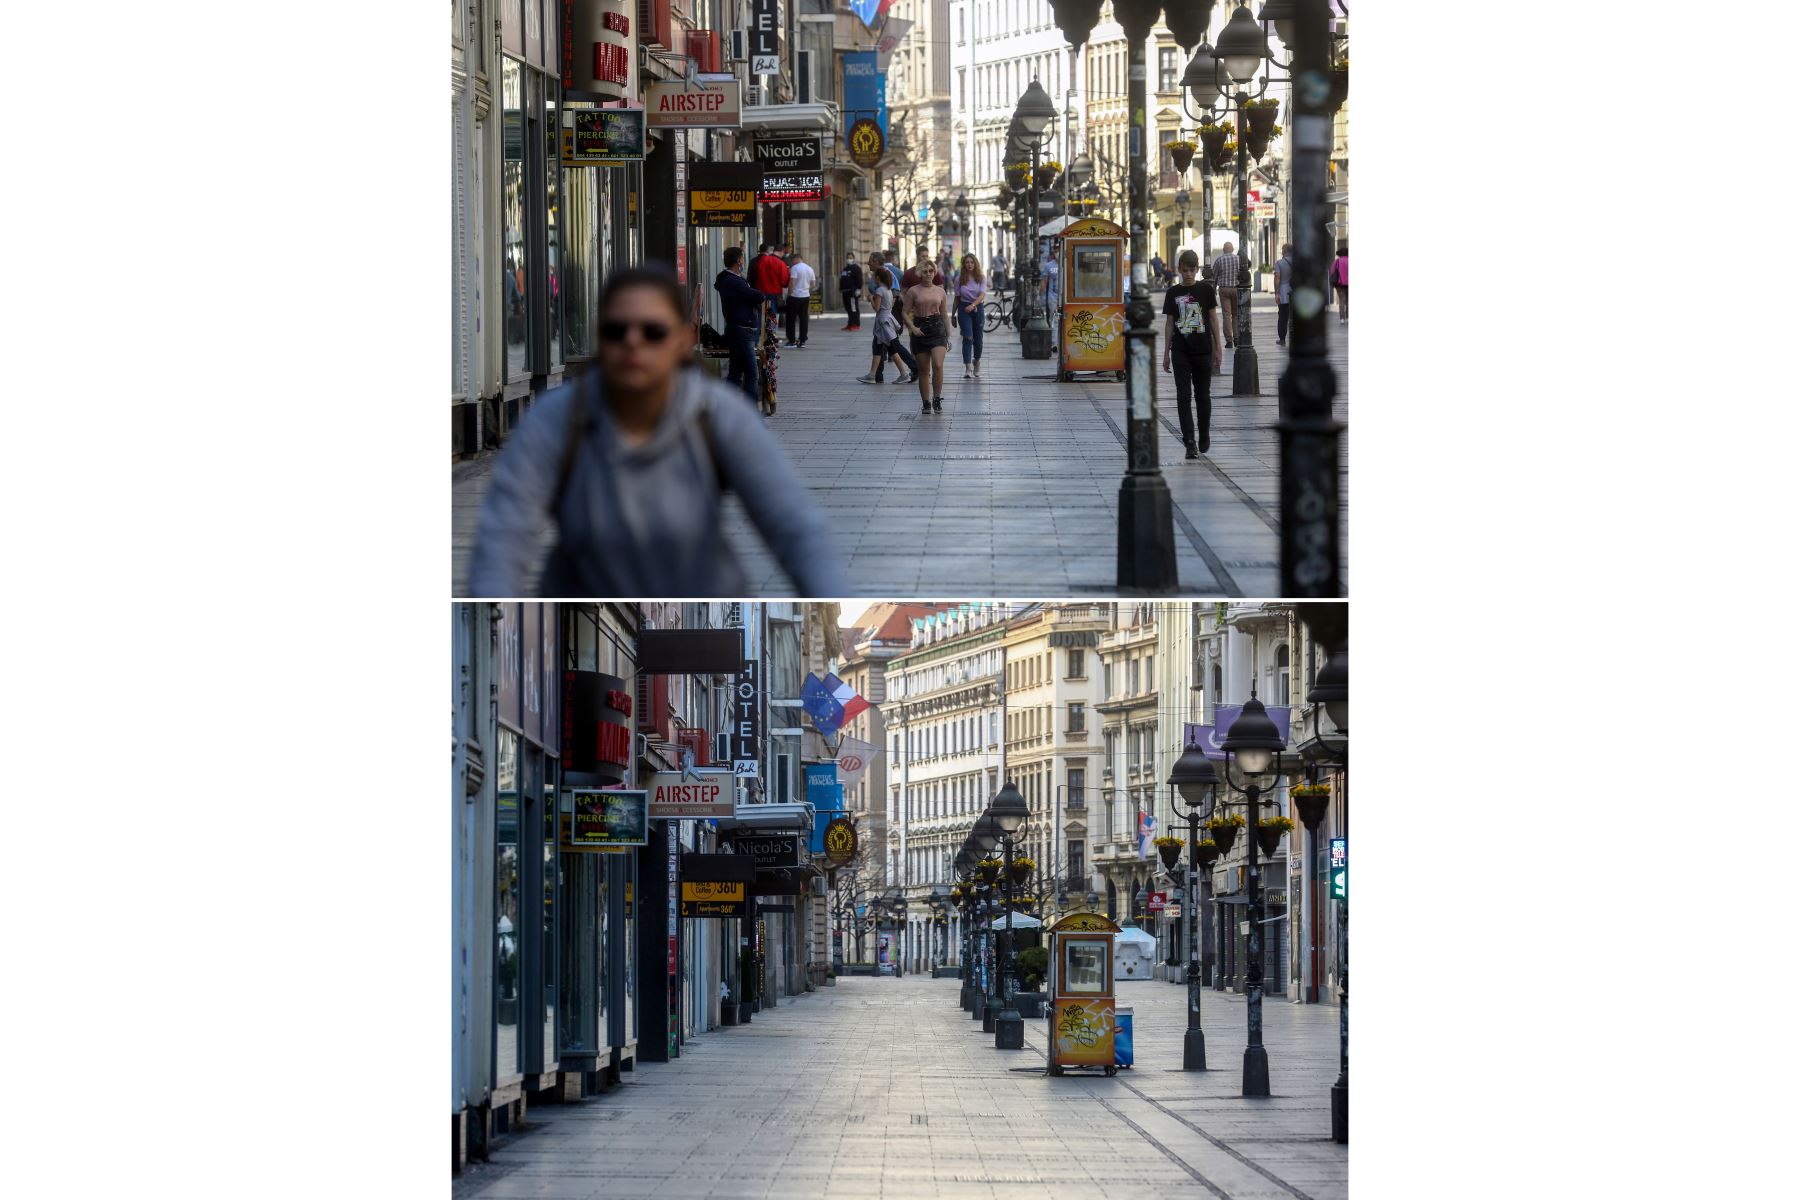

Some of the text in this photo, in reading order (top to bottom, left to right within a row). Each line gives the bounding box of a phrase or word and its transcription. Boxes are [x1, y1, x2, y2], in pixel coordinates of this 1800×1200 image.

[659, 94, 725, 111] AIRSTEP
[576, 112, 620, 123] TATTOO
[757, 142, 815, 158] Nicola'S
[739, 663, 754, 757] HOTEL
[576, 794, 623, 806] TATTOO
[655, 785, 720, 802] AIRSTEP
[739, 840, 793, 855] Nicola'S
